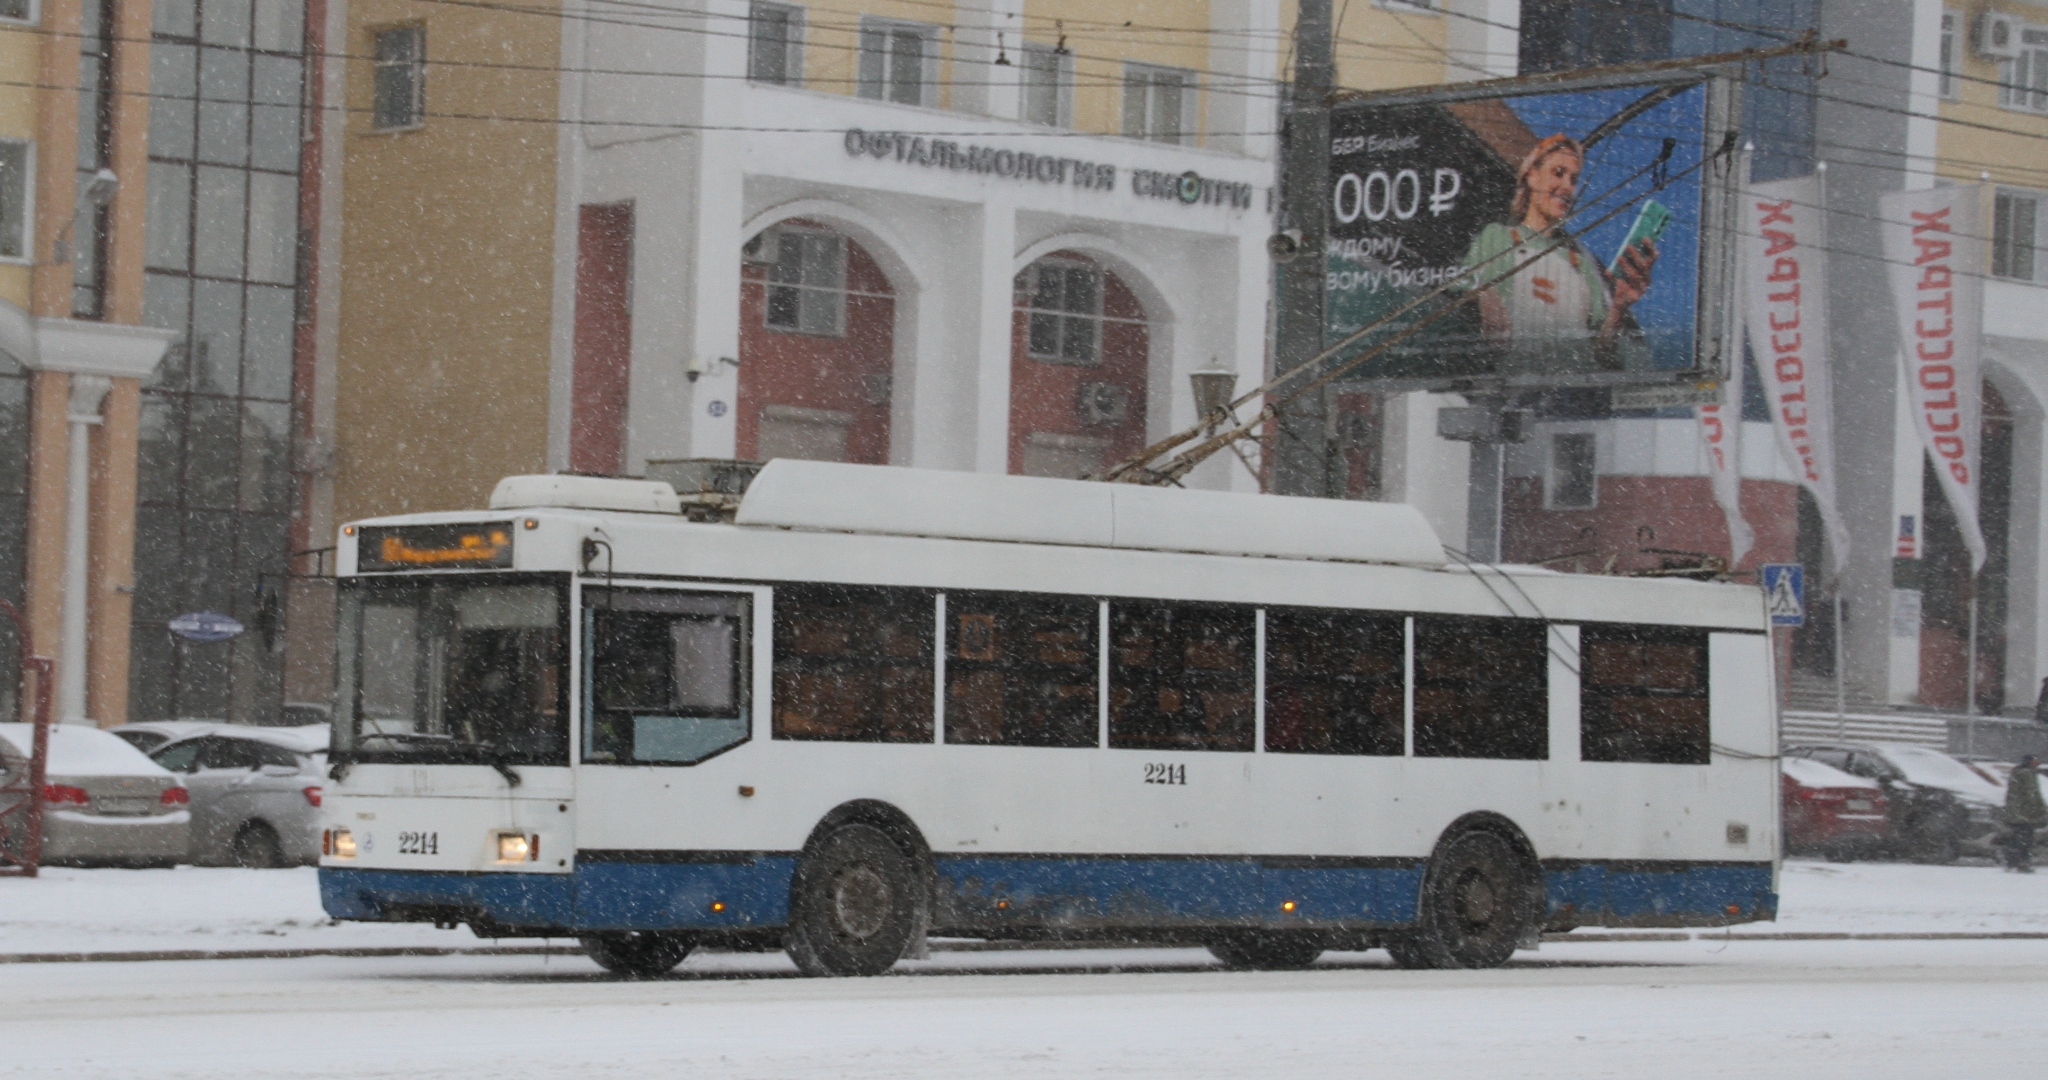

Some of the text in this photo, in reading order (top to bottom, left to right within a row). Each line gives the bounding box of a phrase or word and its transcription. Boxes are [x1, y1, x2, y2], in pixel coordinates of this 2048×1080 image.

[844, 128, 1117, 191] ОФТАЛЬМОЛОГИЯ
[1132, 169, 1253, 210] СМОТРИ
[1334, 168, 1421, 223] 000
[1144, 762, 1187, 785] 2214
[398, 831, 439, 855] 2214
